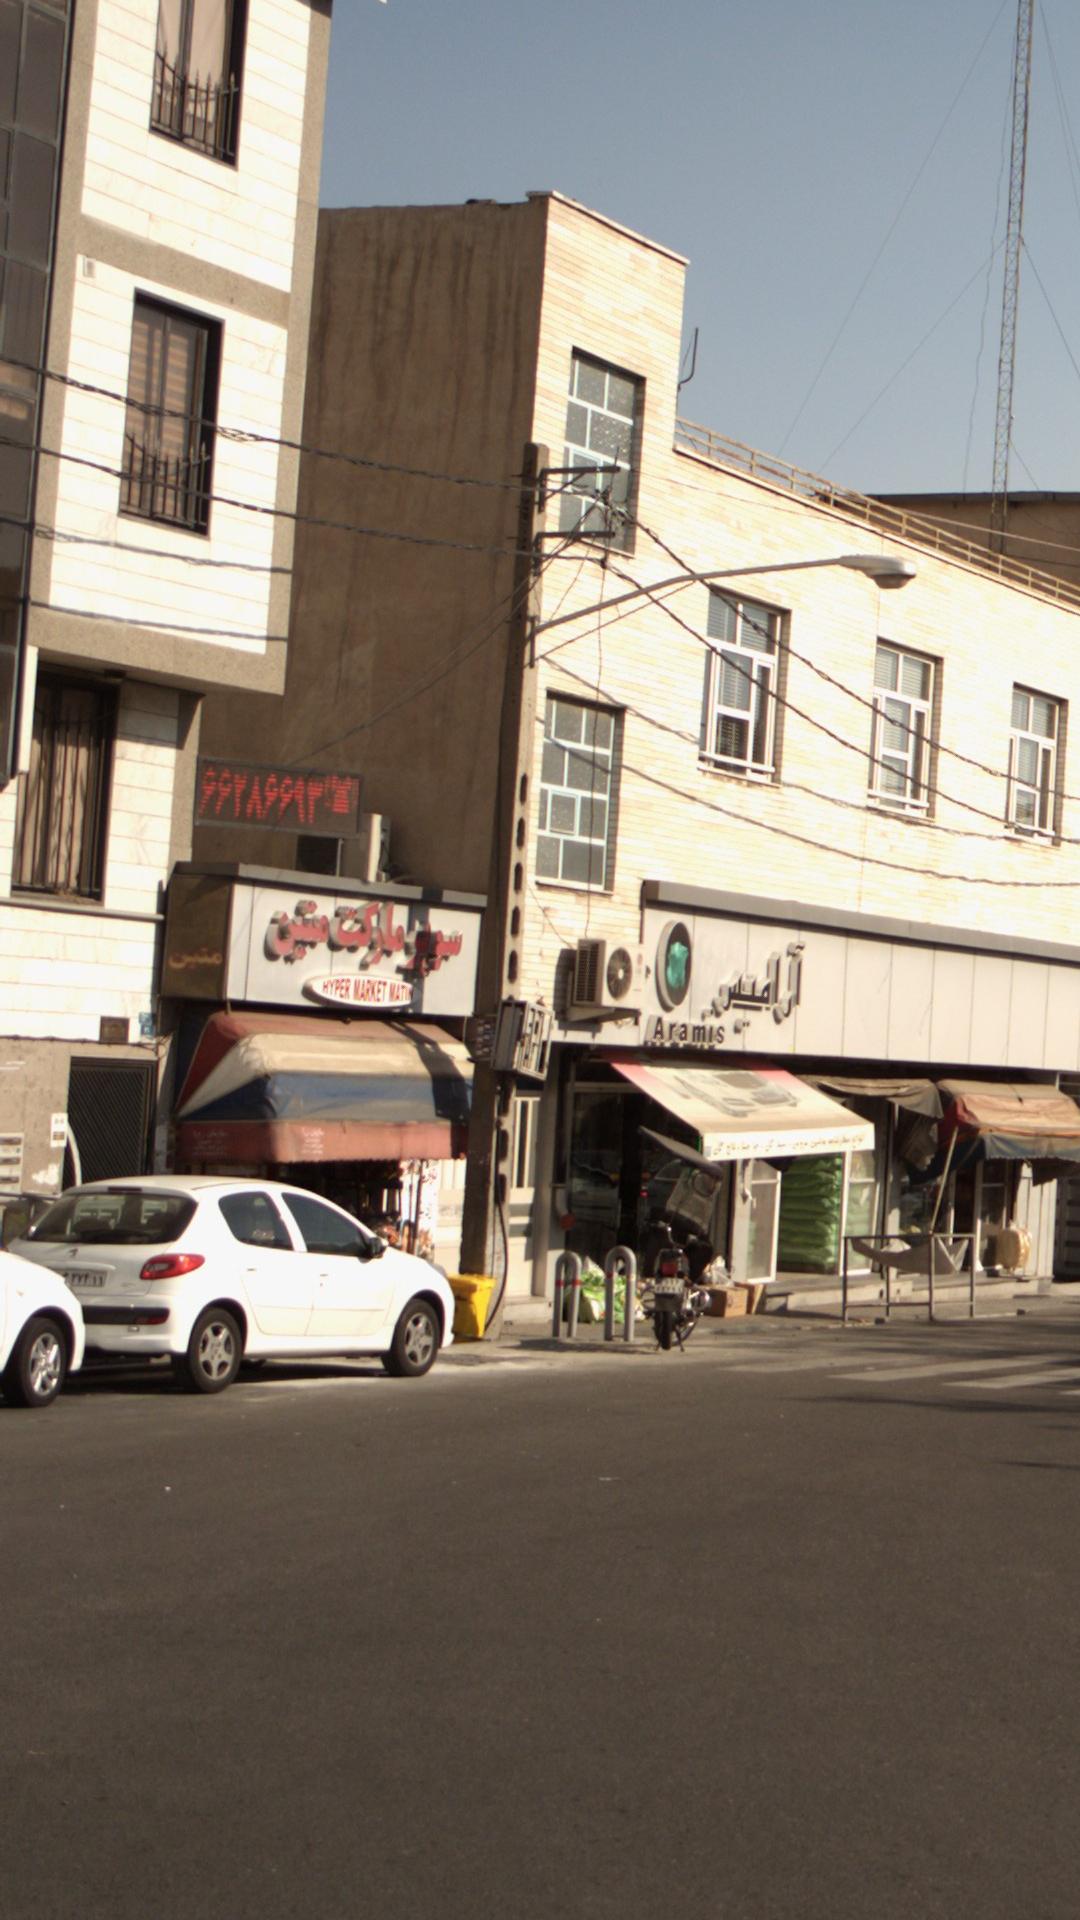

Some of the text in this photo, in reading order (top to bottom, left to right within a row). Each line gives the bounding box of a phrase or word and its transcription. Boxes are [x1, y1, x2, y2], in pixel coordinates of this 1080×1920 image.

[265, 900, 329, 962] متین
[328, 901, 406, 970] مارکت
[322, 978, 351, 1000] HYPER
[353, 979, 388, 1002] MARKET
[648, 1015, 725, 1045] Aramis
